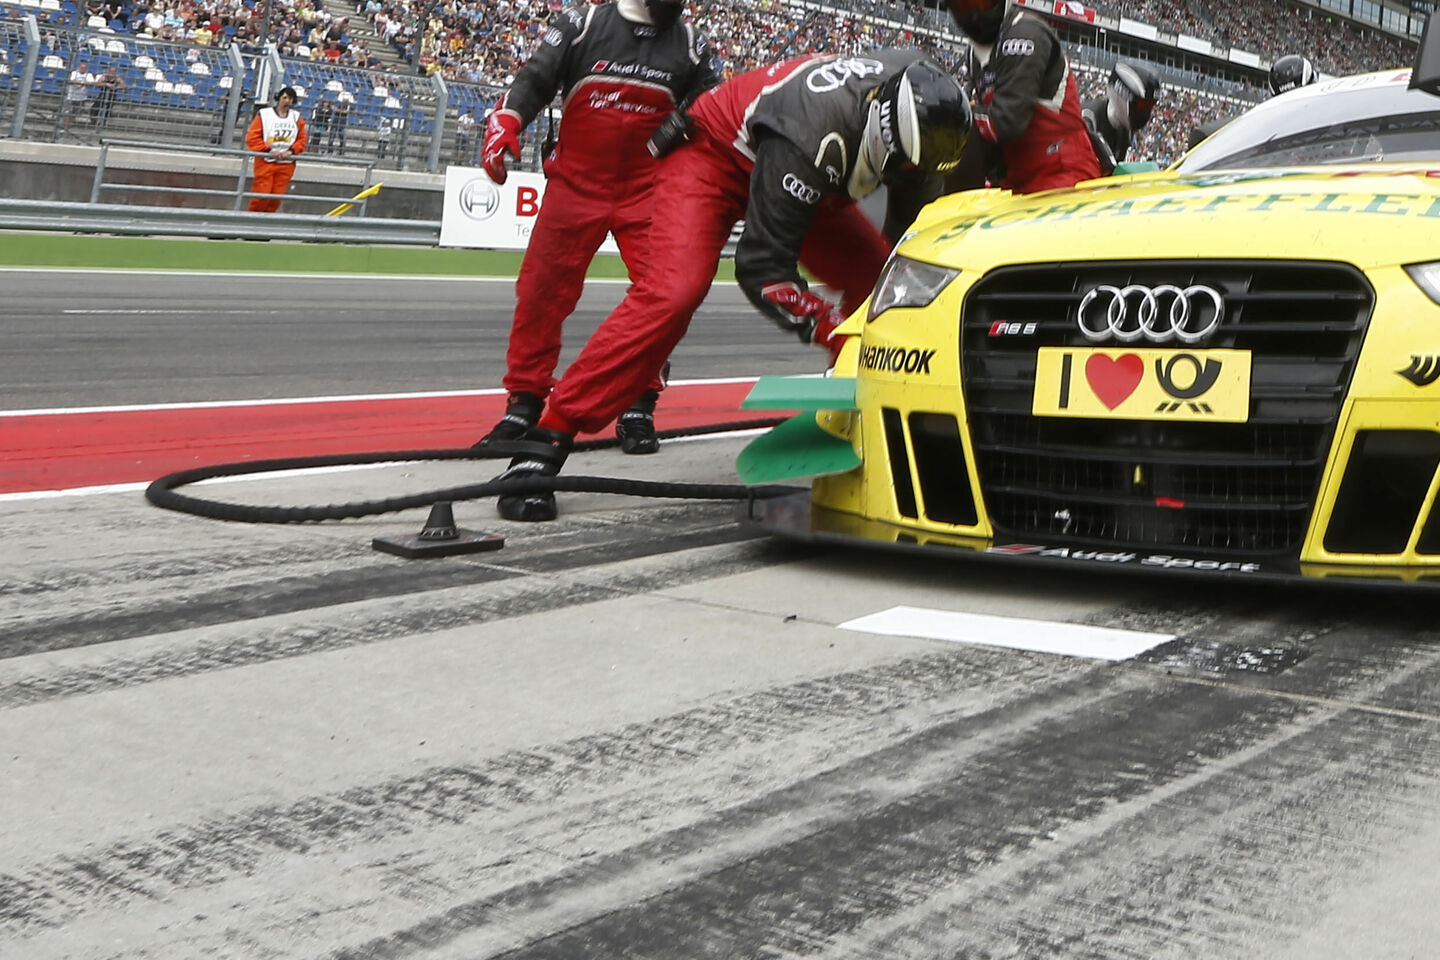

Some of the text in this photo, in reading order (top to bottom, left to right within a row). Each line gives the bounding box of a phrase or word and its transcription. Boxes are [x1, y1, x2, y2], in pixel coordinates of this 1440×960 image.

[608, 62, 673, 81] Audi Sport
[1058, 353, 1072, 410] I
[1039, 547, 1261, 573] Audi Sport
